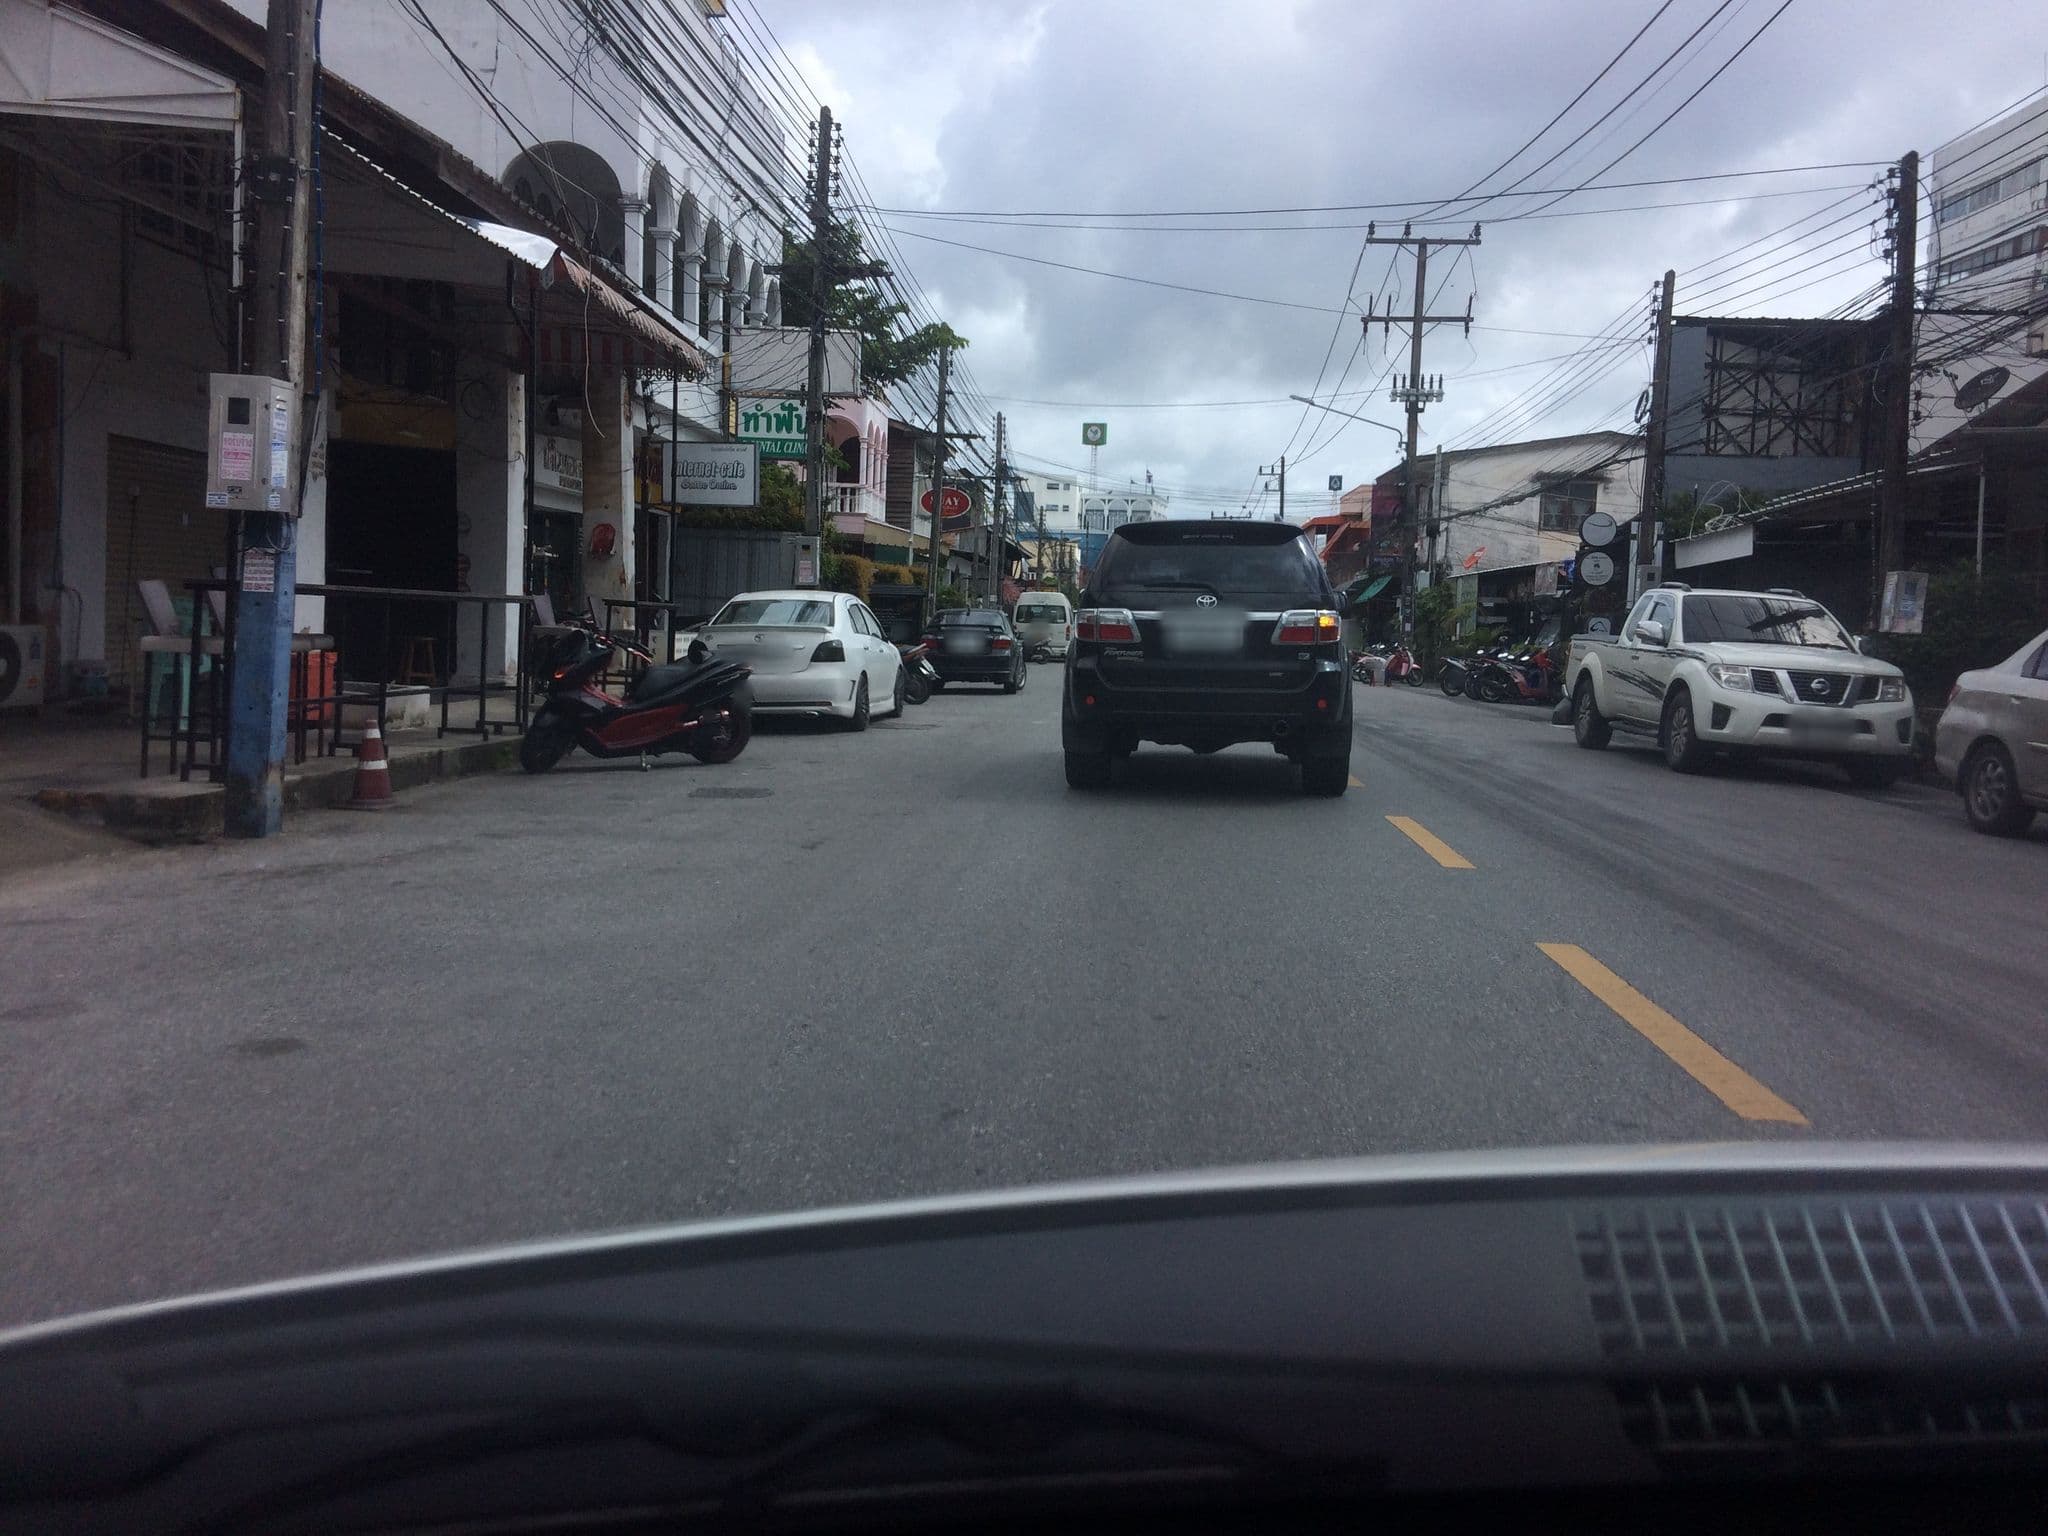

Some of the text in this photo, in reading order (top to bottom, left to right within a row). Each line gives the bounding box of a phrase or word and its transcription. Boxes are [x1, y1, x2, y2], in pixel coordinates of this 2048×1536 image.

[752, 440, 782, 453] NTAL
[783, 441, 808, 454] CLINI
[929, 495, 961, 506] SAY
